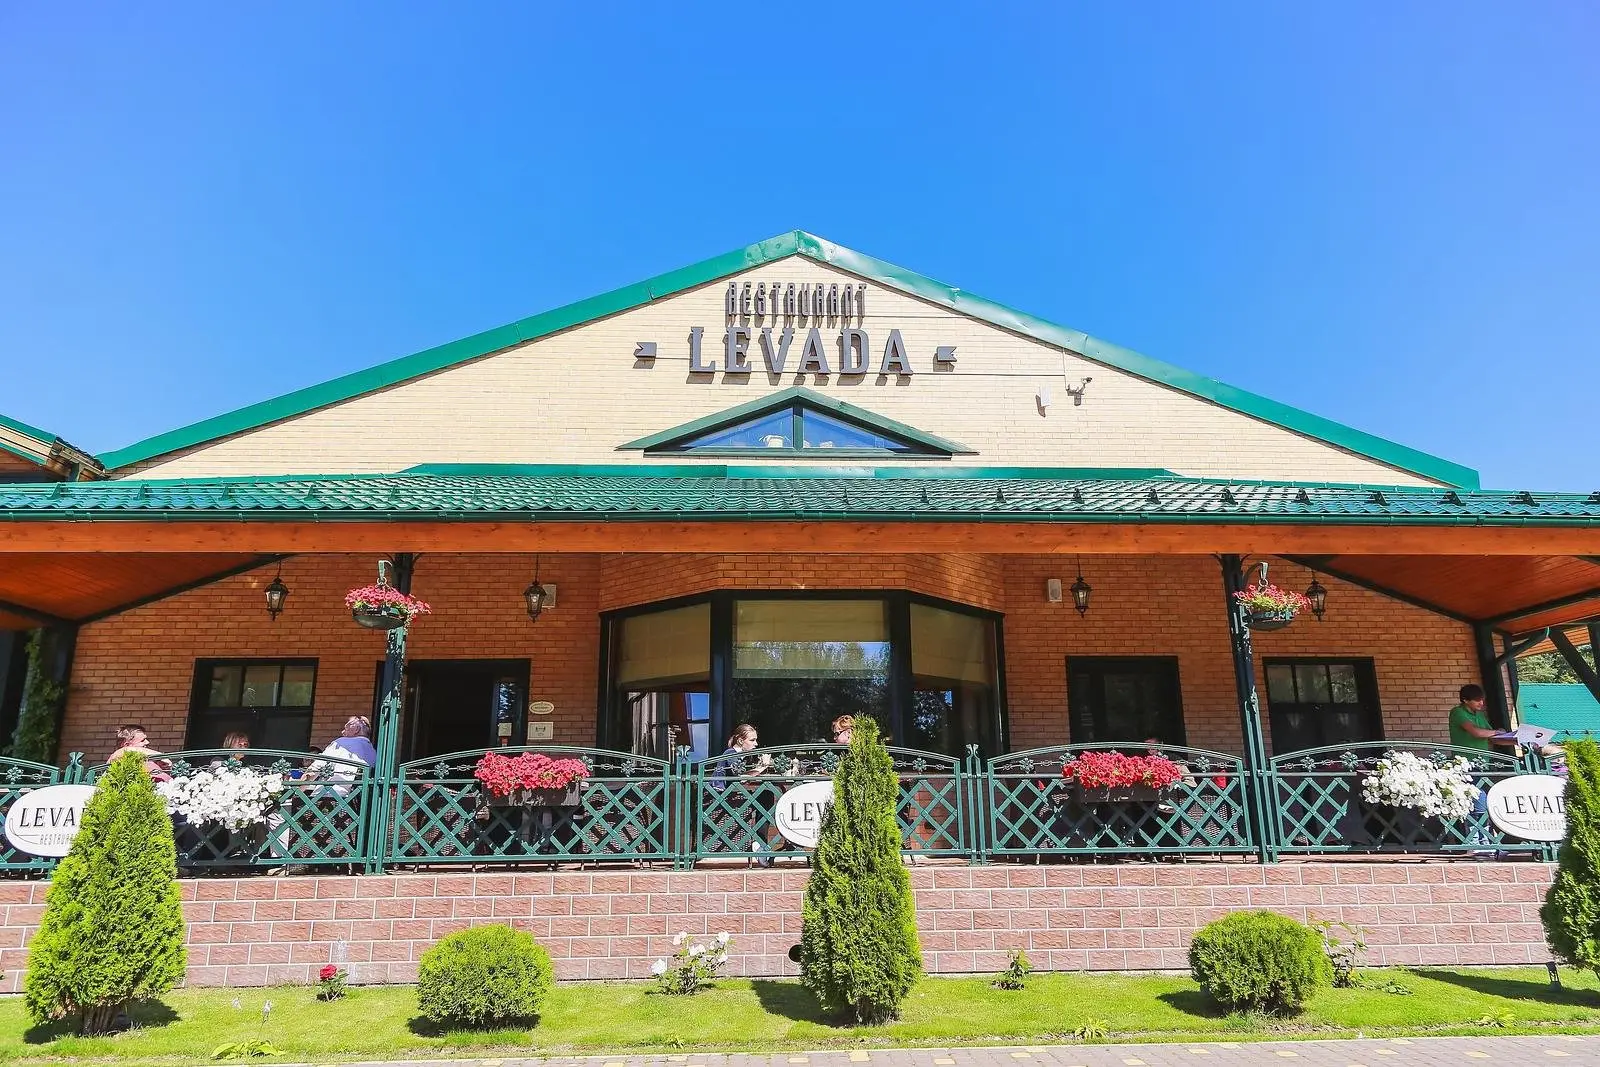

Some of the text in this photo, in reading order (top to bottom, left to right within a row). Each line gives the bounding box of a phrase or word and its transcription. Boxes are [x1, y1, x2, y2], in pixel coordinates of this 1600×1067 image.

[728, 281, 867, 317] RESTAURANT
[689, 326, 914, 375] LEVADA
[19, 806, 88, 828] LEVA
[1503, 795, 1565, 814] LEVAD
